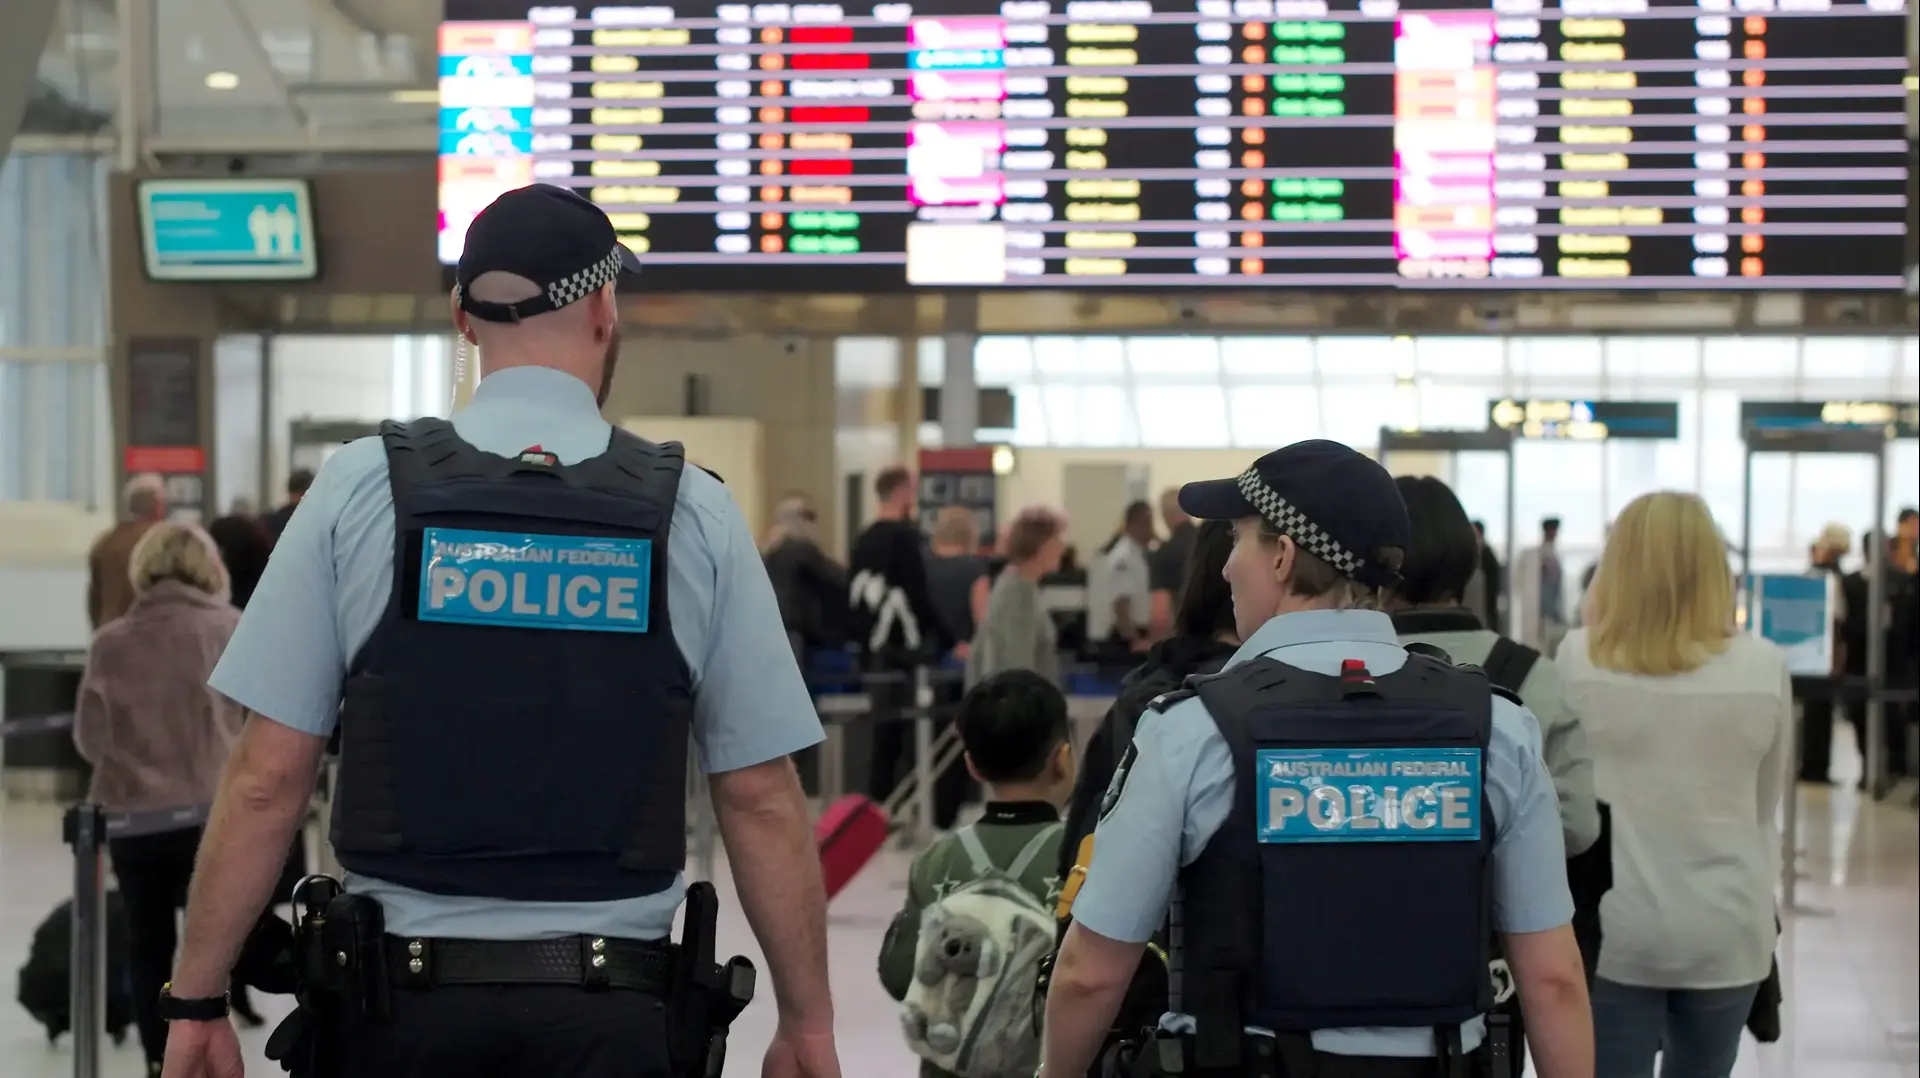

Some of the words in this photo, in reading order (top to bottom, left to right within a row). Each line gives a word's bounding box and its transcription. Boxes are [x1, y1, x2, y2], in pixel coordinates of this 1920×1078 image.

[434, 541, 553, 563] AUSTRALIAN
[557, 549, 639, 567] FEDERAL
[431, 567, 639, 619] POLICE
[1271, 761, 1387, 777] AUSTRALIAN
[1392, 761, 1472, 777] FEDERAL
[1268, 785, 1472, 830] POLICE
